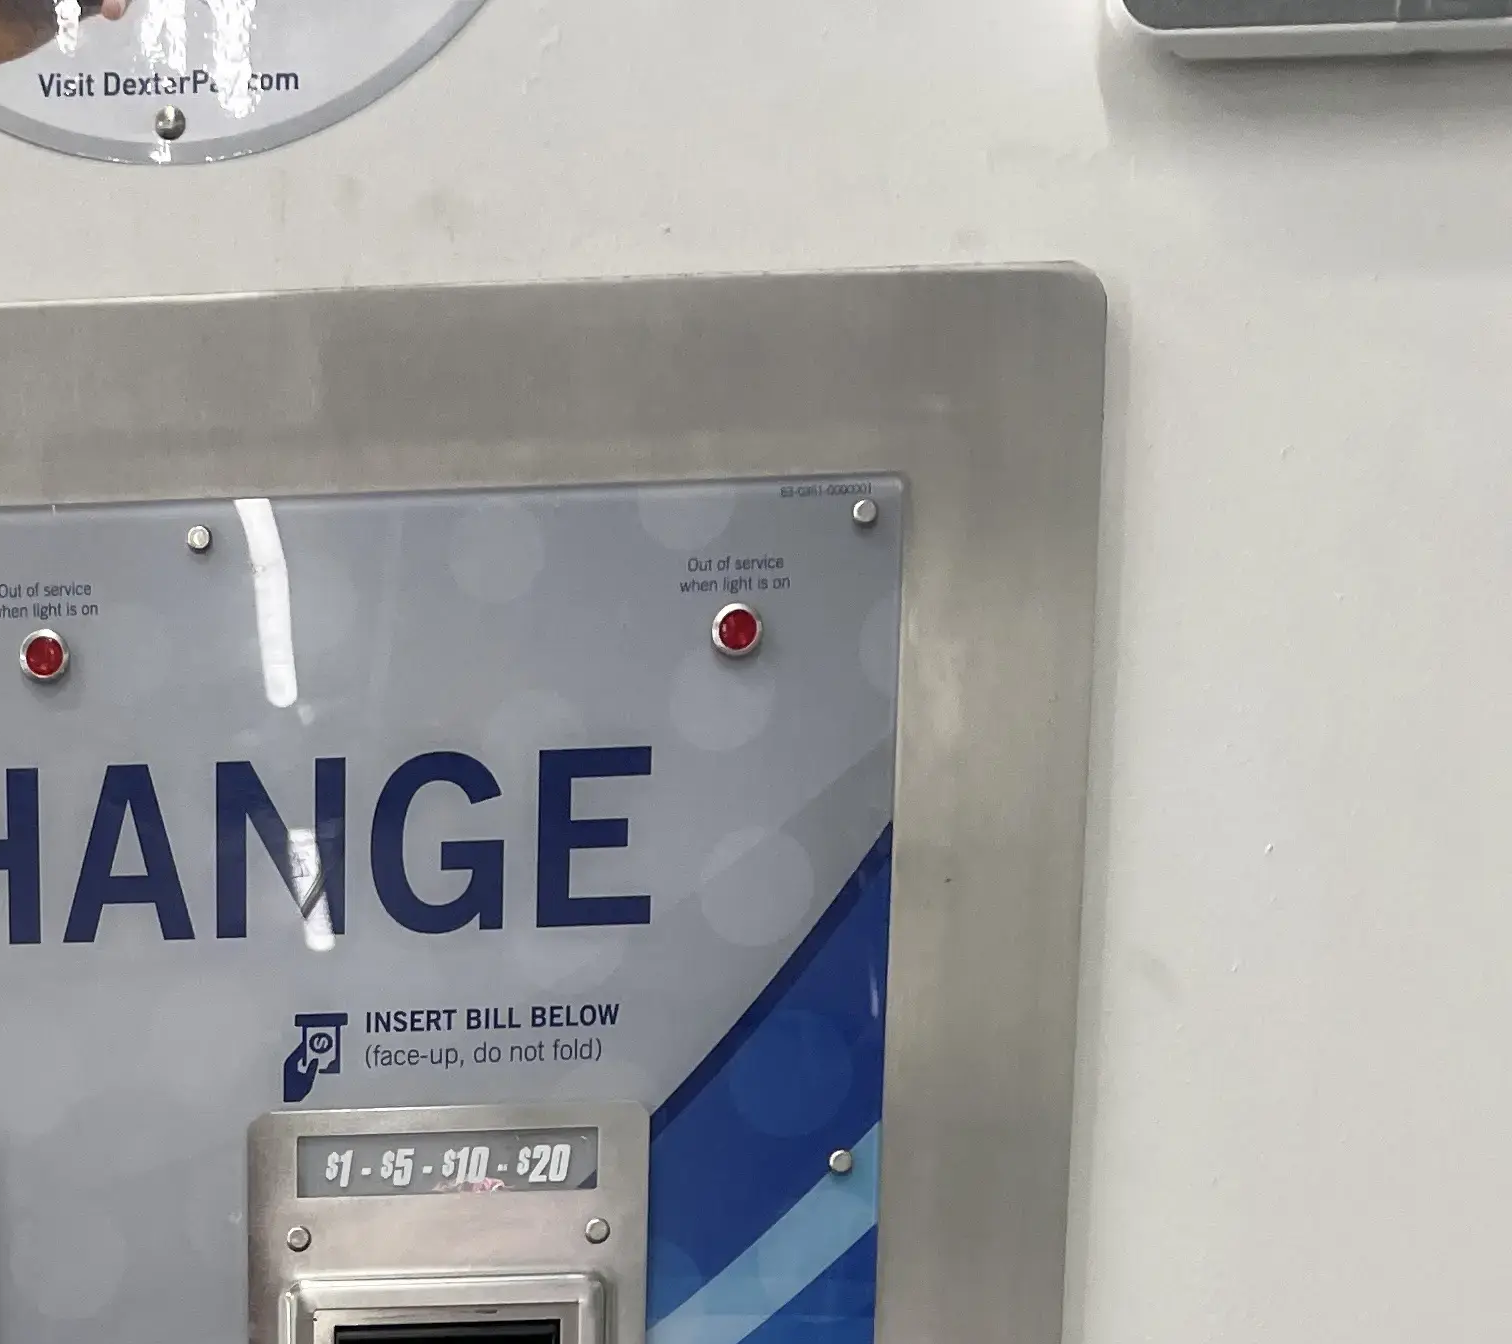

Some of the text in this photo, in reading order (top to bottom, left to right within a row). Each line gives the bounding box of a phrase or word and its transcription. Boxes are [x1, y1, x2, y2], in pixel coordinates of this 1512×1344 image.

[38, 72, 94, 98] Visit
[687, 555, 784, 573] Out of service
[26, 581, 40, 598] of
[43, 581, 92, 597] service
[679, 576, 791, 594] when light is on
[32, 602, 62, 620] light
[66, 603, 78, 617] is
[81, 604, 99, 616] on
[365, 1003, 621, 1034] INSERT BILL BELOW
[364, 1036, 603, 1070] (face-up, do not fold)
[325, 1149, 354, 1188] $1
[379, 1147, 415, 1187] $5
[441, 1145, 490, 1185] $10
[516, 1143, 572, 1183] $20
